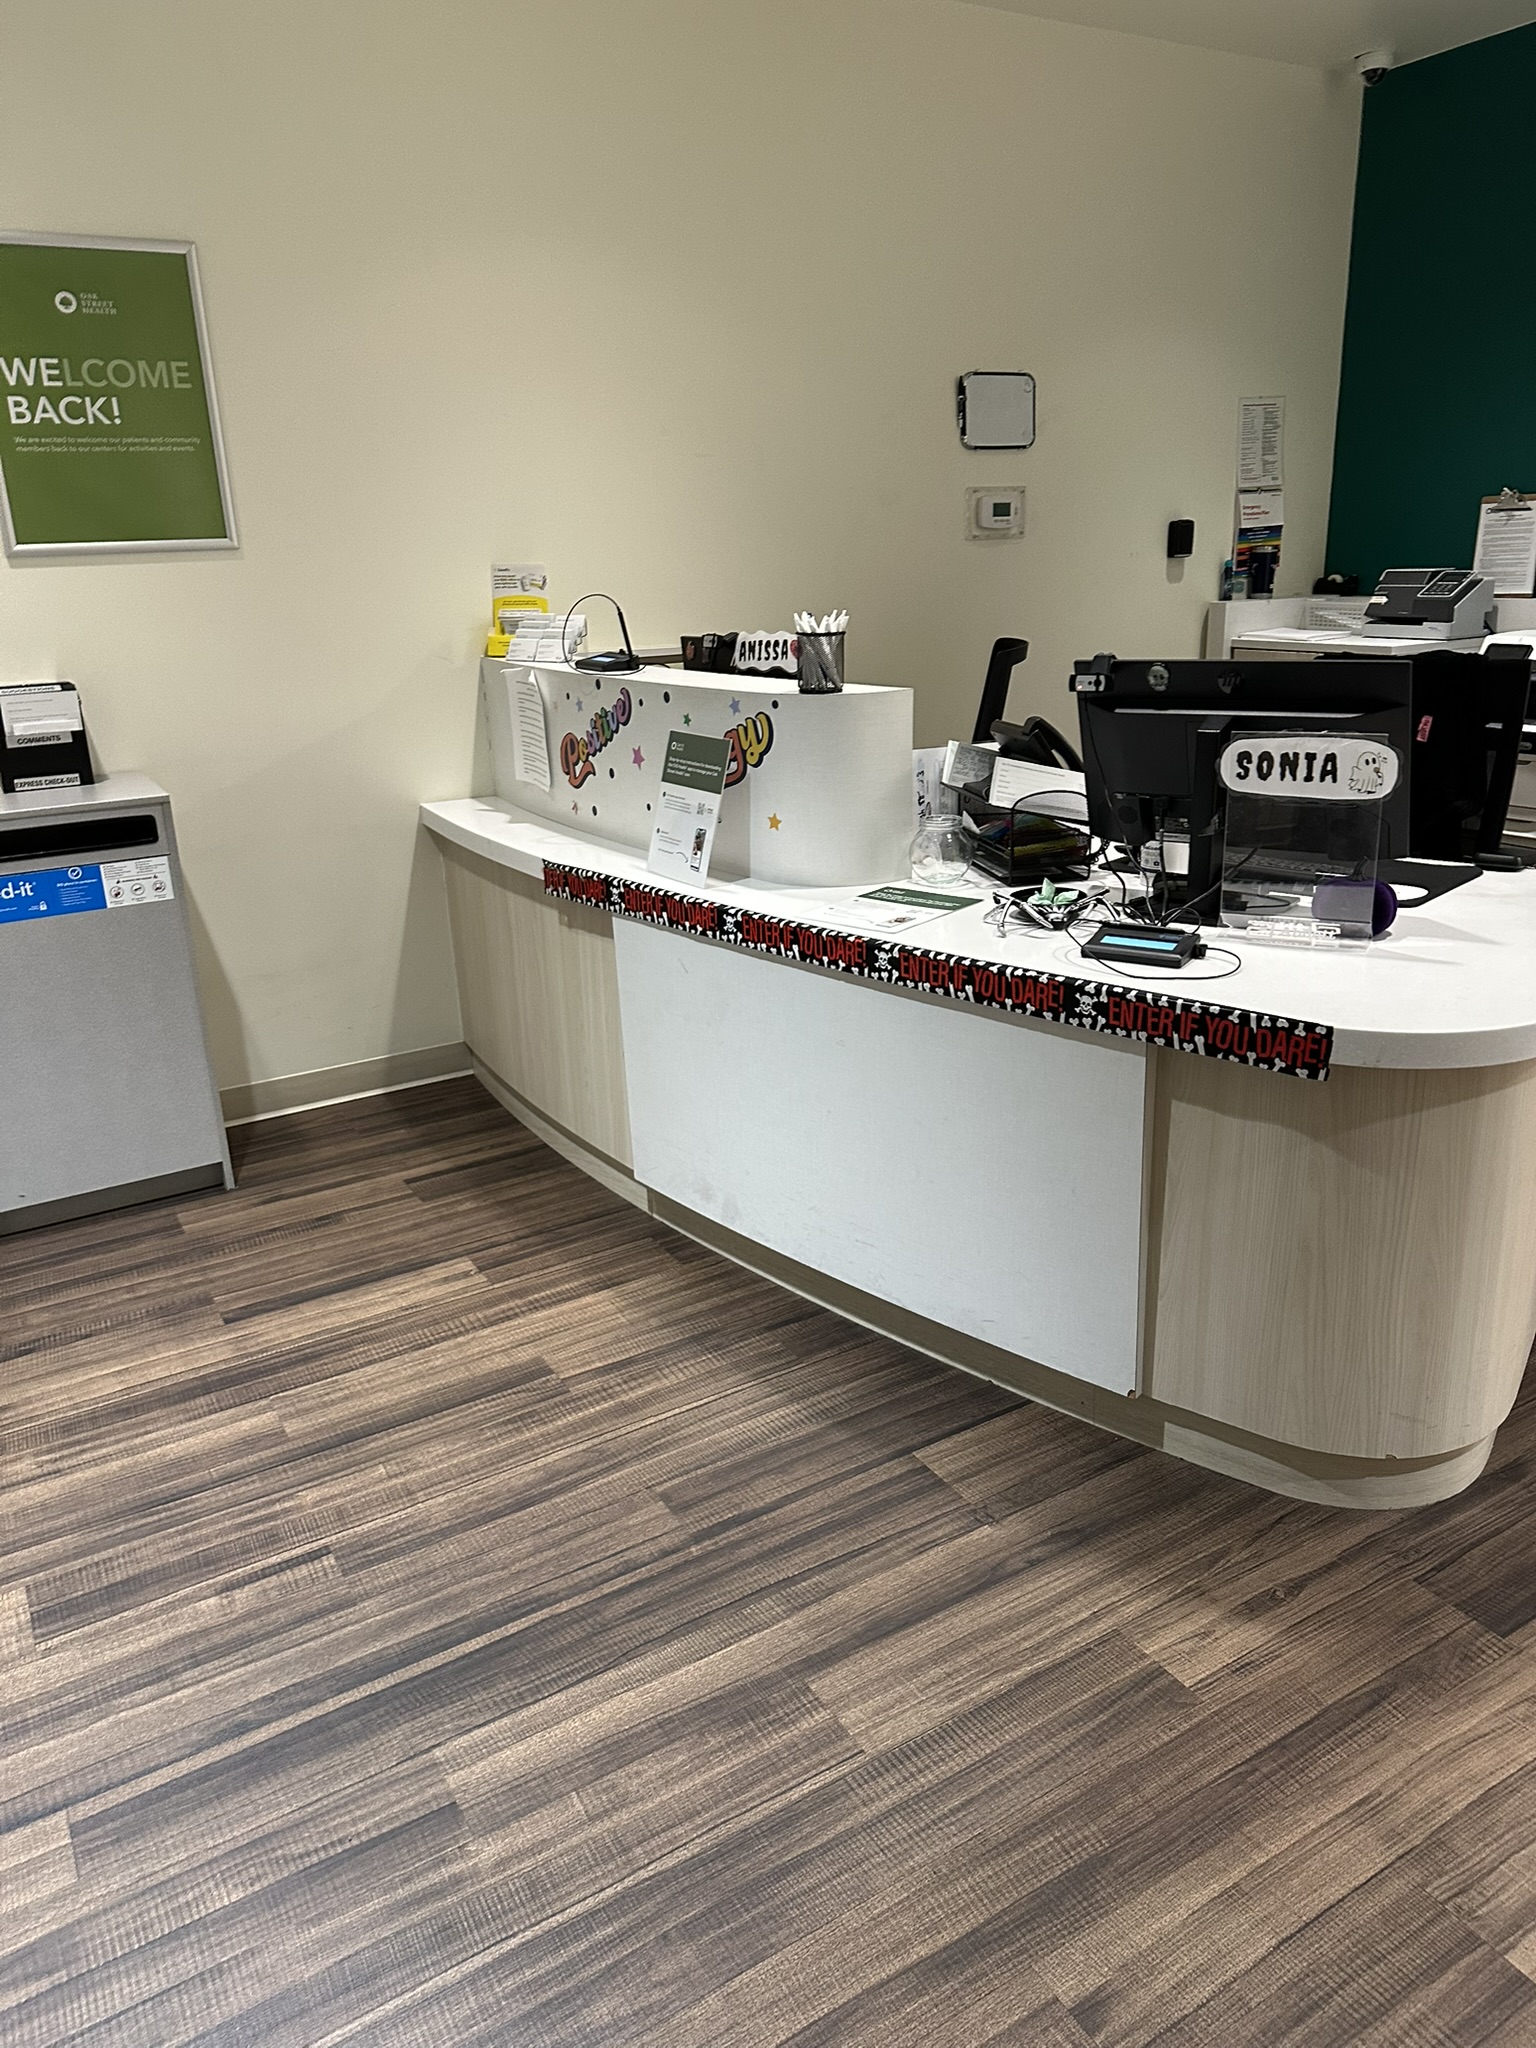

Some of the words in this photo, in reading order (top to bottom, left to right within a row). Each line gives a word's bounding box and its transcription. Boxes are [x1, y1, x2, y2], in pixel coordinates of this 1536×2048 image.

[80, 292, 98, 300] OAK
[81, 300, 114, 308] STREET
[82, 307, 117, 315] HEALTH
[0, 357, 193, 388] WELCOME
[7, 396, 122, 425] BACK!
[739, 639, 789, 662] ANISSA
[16, 734, 62, 745] COMMENTS
[560, 687, 633, 789] Positive
[1236, 750, 1338, 784] SONIA
[15, 779, 44, 789] EXPRESS
[44, 776, 79, 786] CHECK-OUT
[0, 881, 34, 899] d-it
[567, 873, 583, 897] YOU
[583, 877, 606, 901] DARE!
[624, 888, 654, 913] ENTER
[654, 895, 664, 916] IF
[666, 897, 686, 925] YOU
[687, 902, 718, 931] DARE!
[742, 915, 779, 947] ENTER
[783, 925, 794, 950] IF
[796, 928, 823, 959] YOU
[826, 936, 867, 967] DARE!
[900, 952, 949, 987] ENTER
[953, 963, 968, 990] IF
[972, 966, 1006, 1002] YOU
[1010, 977, 1064, 1012] DARE!
[1108, 996, 1175, 1039] ENTER
[1179, 1011, 1199, 1040] IF
[1205, 1015, 1250, 1056] YOU
[1256, 1028, 1328, 1069] DARE!
